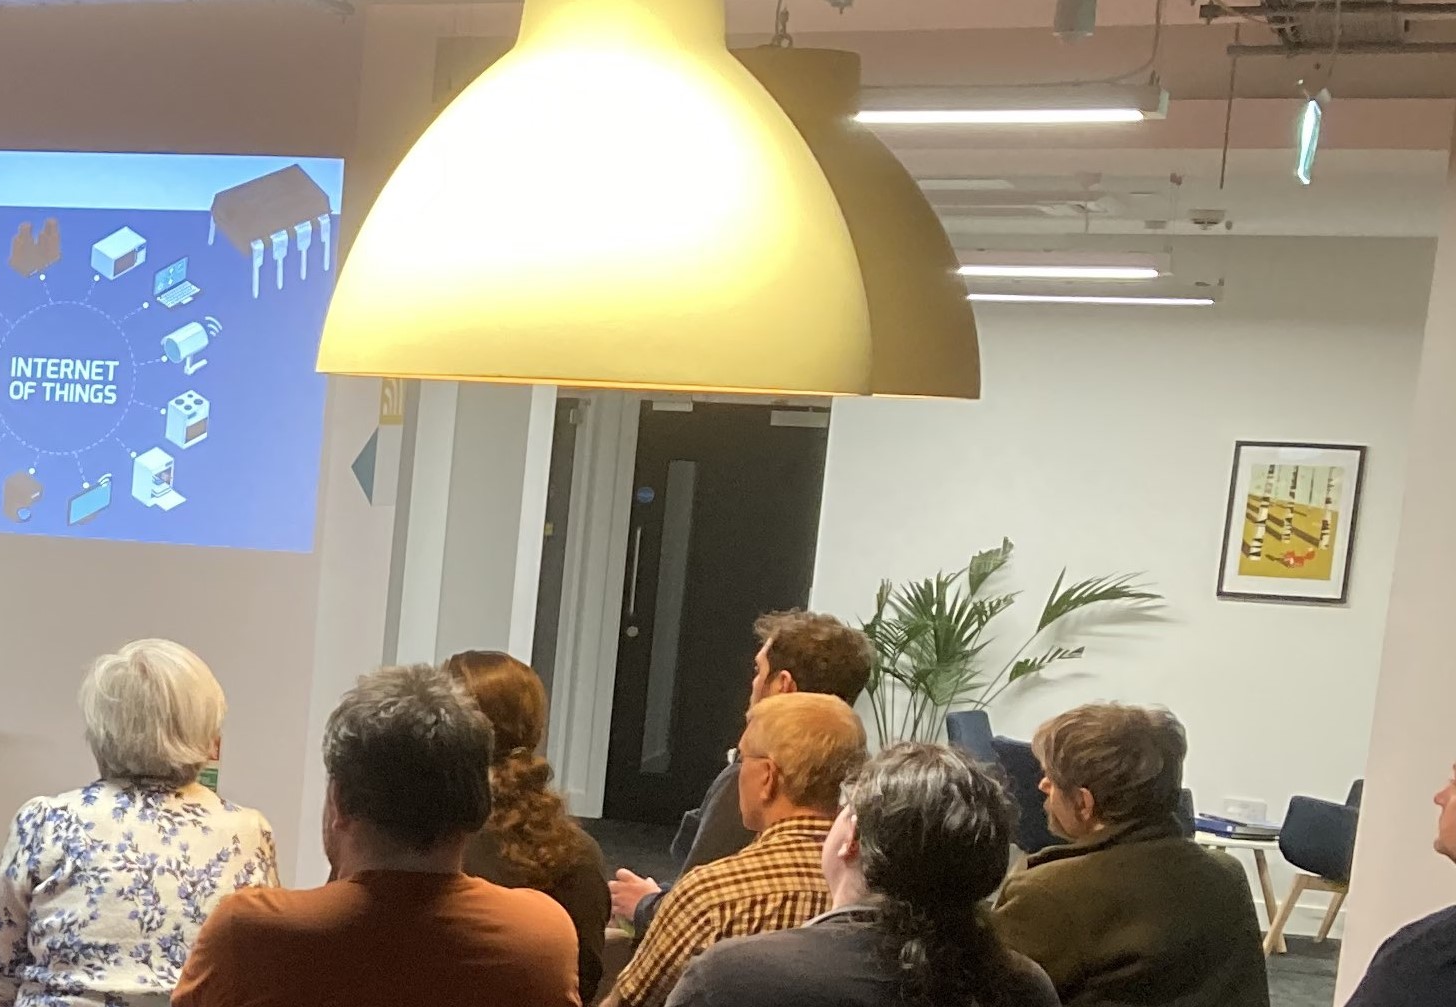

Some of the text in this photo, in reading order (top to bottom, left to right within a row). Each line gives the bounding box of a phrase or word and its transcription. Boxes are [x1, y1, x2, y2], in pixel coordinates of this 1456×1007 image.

[11, 356, 120, 382] INTERNET
[9, 380, 117, 405] OF THINGS
